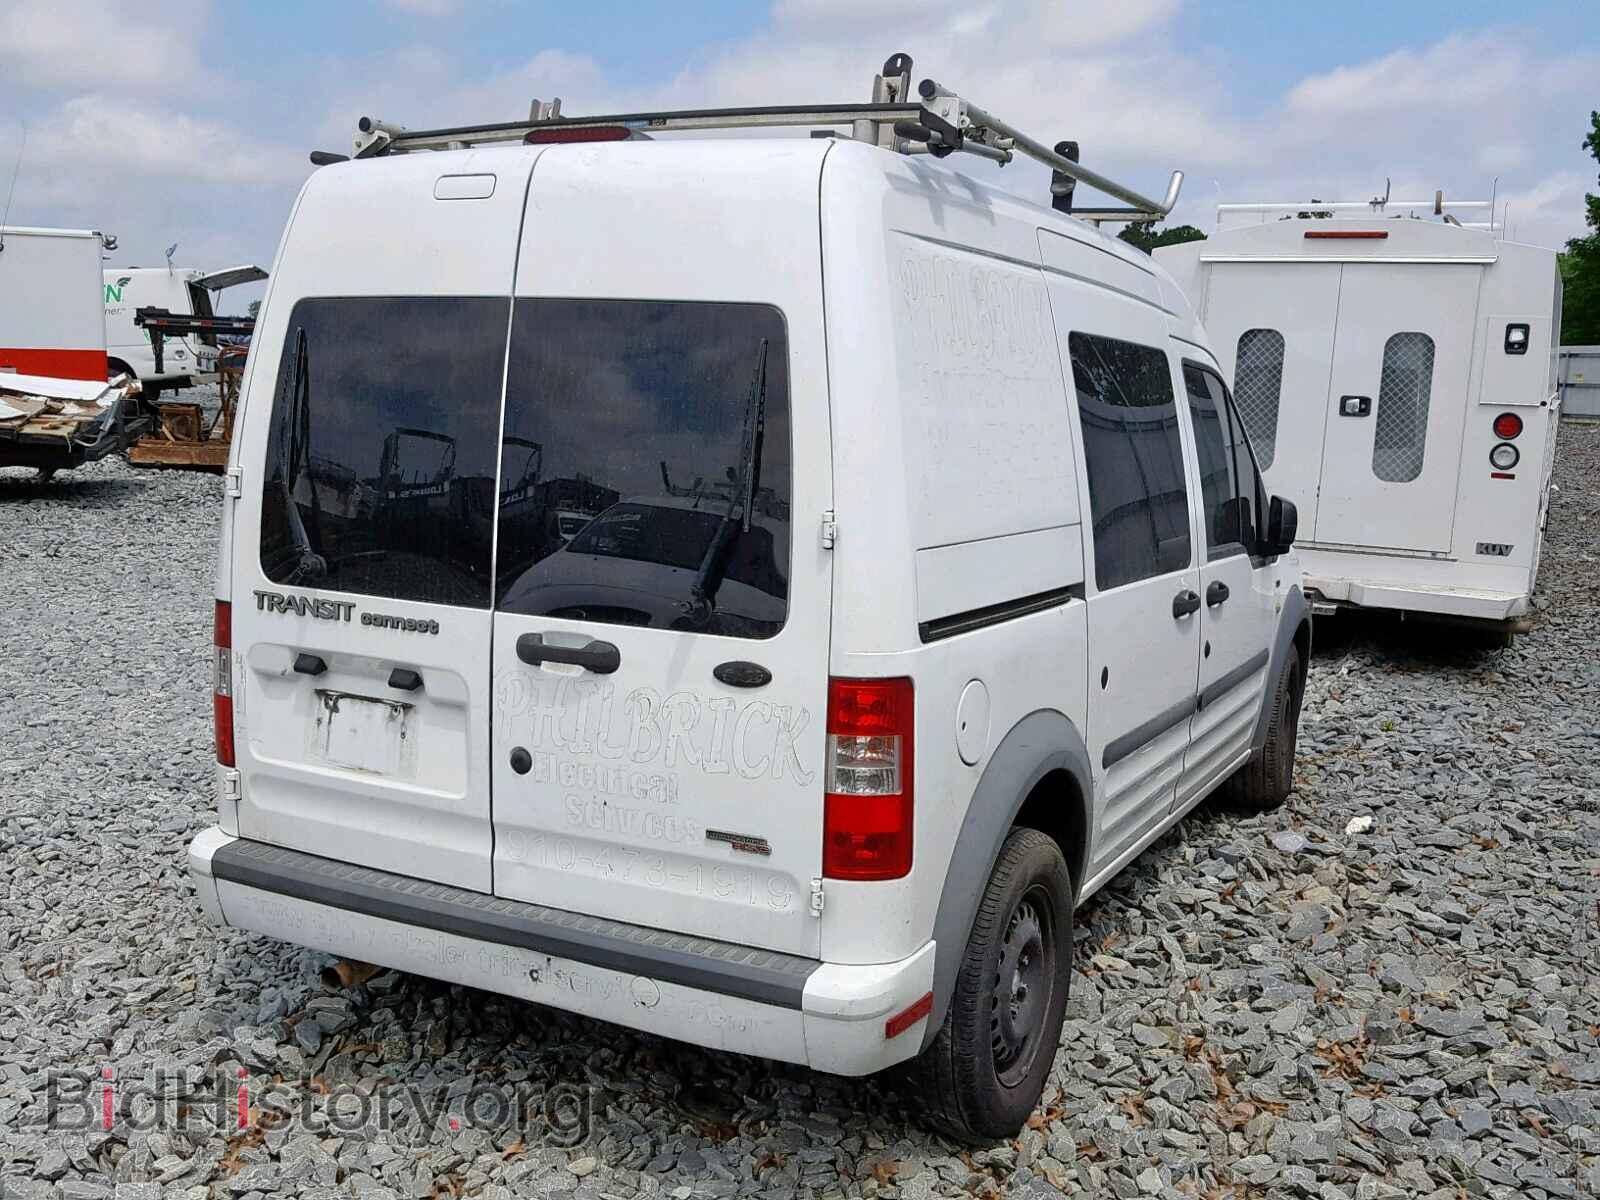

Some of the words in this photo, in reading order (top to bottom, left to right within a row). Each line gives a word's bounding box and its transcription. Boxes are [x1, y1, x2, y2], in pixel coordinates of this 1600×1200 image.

[103, 284, 122, 303] N
[1475, 542, 1514, 557] KUV
[253, 590, 356, 622] TRANSIT
[361, 612, 440, 635] connect
[496, 669, 816, 787] PHILBRICK
[504, 829, 793, 910] 910-473-1919
